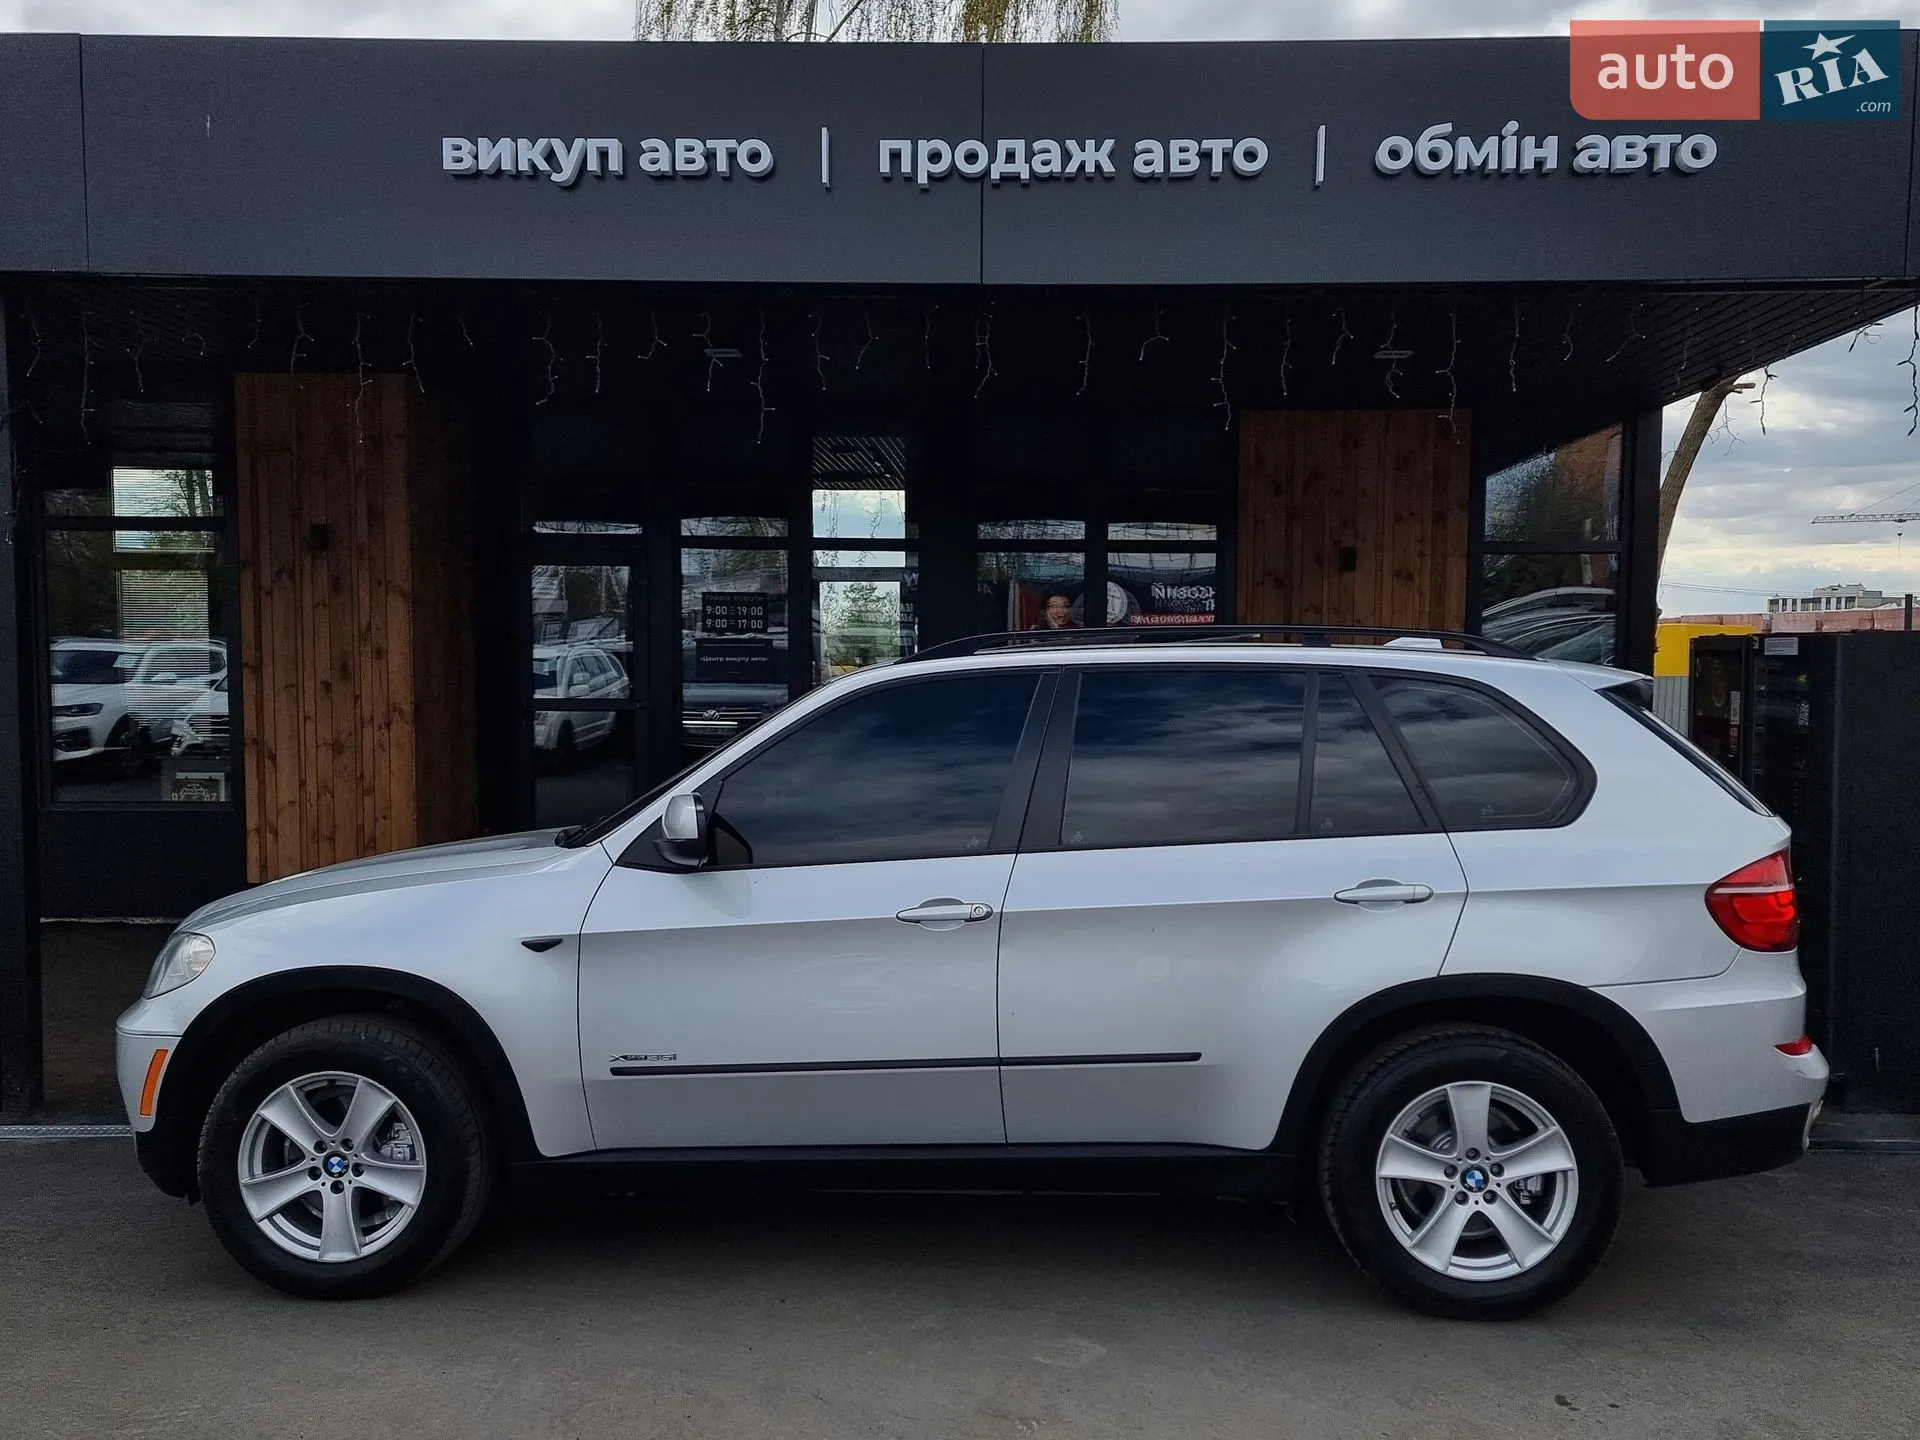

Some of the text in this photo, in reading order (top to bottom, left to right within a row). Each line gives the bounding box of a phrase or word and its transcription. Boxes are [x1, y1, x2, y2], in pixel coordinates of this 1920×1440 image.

[442, 136, 623, 187] викуп
[638, 136, 775, 178] авто
[878, 137, 1117, 189] продаж
[1132, 136, 1270, 179] авто
[1374, 120, 1559, 175] обмін
[1573, 133, 1719, 174] авто
[706, 605, 728, 615] 9:00
[737, 606, 763, 616] 19:00
[706, 619, 728, 628] 9:00
[737, 619, 763, 629] 17:00
